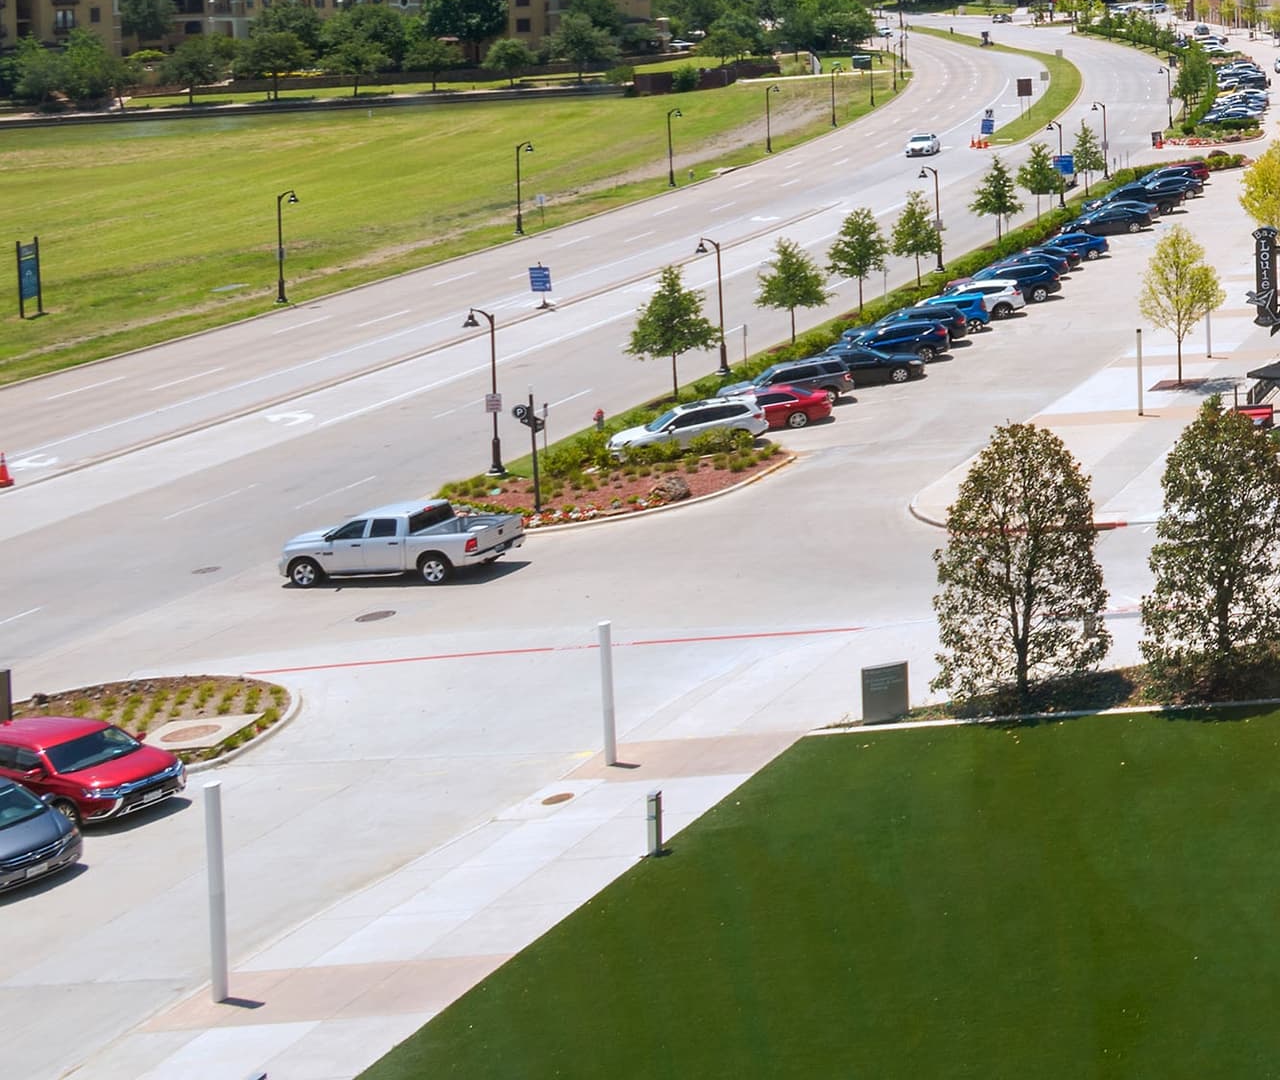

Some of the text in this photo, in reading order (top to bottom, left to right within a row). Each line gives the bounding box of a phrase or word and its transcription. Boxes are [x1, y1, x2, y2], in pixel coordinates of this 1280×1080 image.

[1253, 230, 1276, 240] Bar
[1260, 240, 1270, 290] Louie
[516, 408, 523, 417] P
